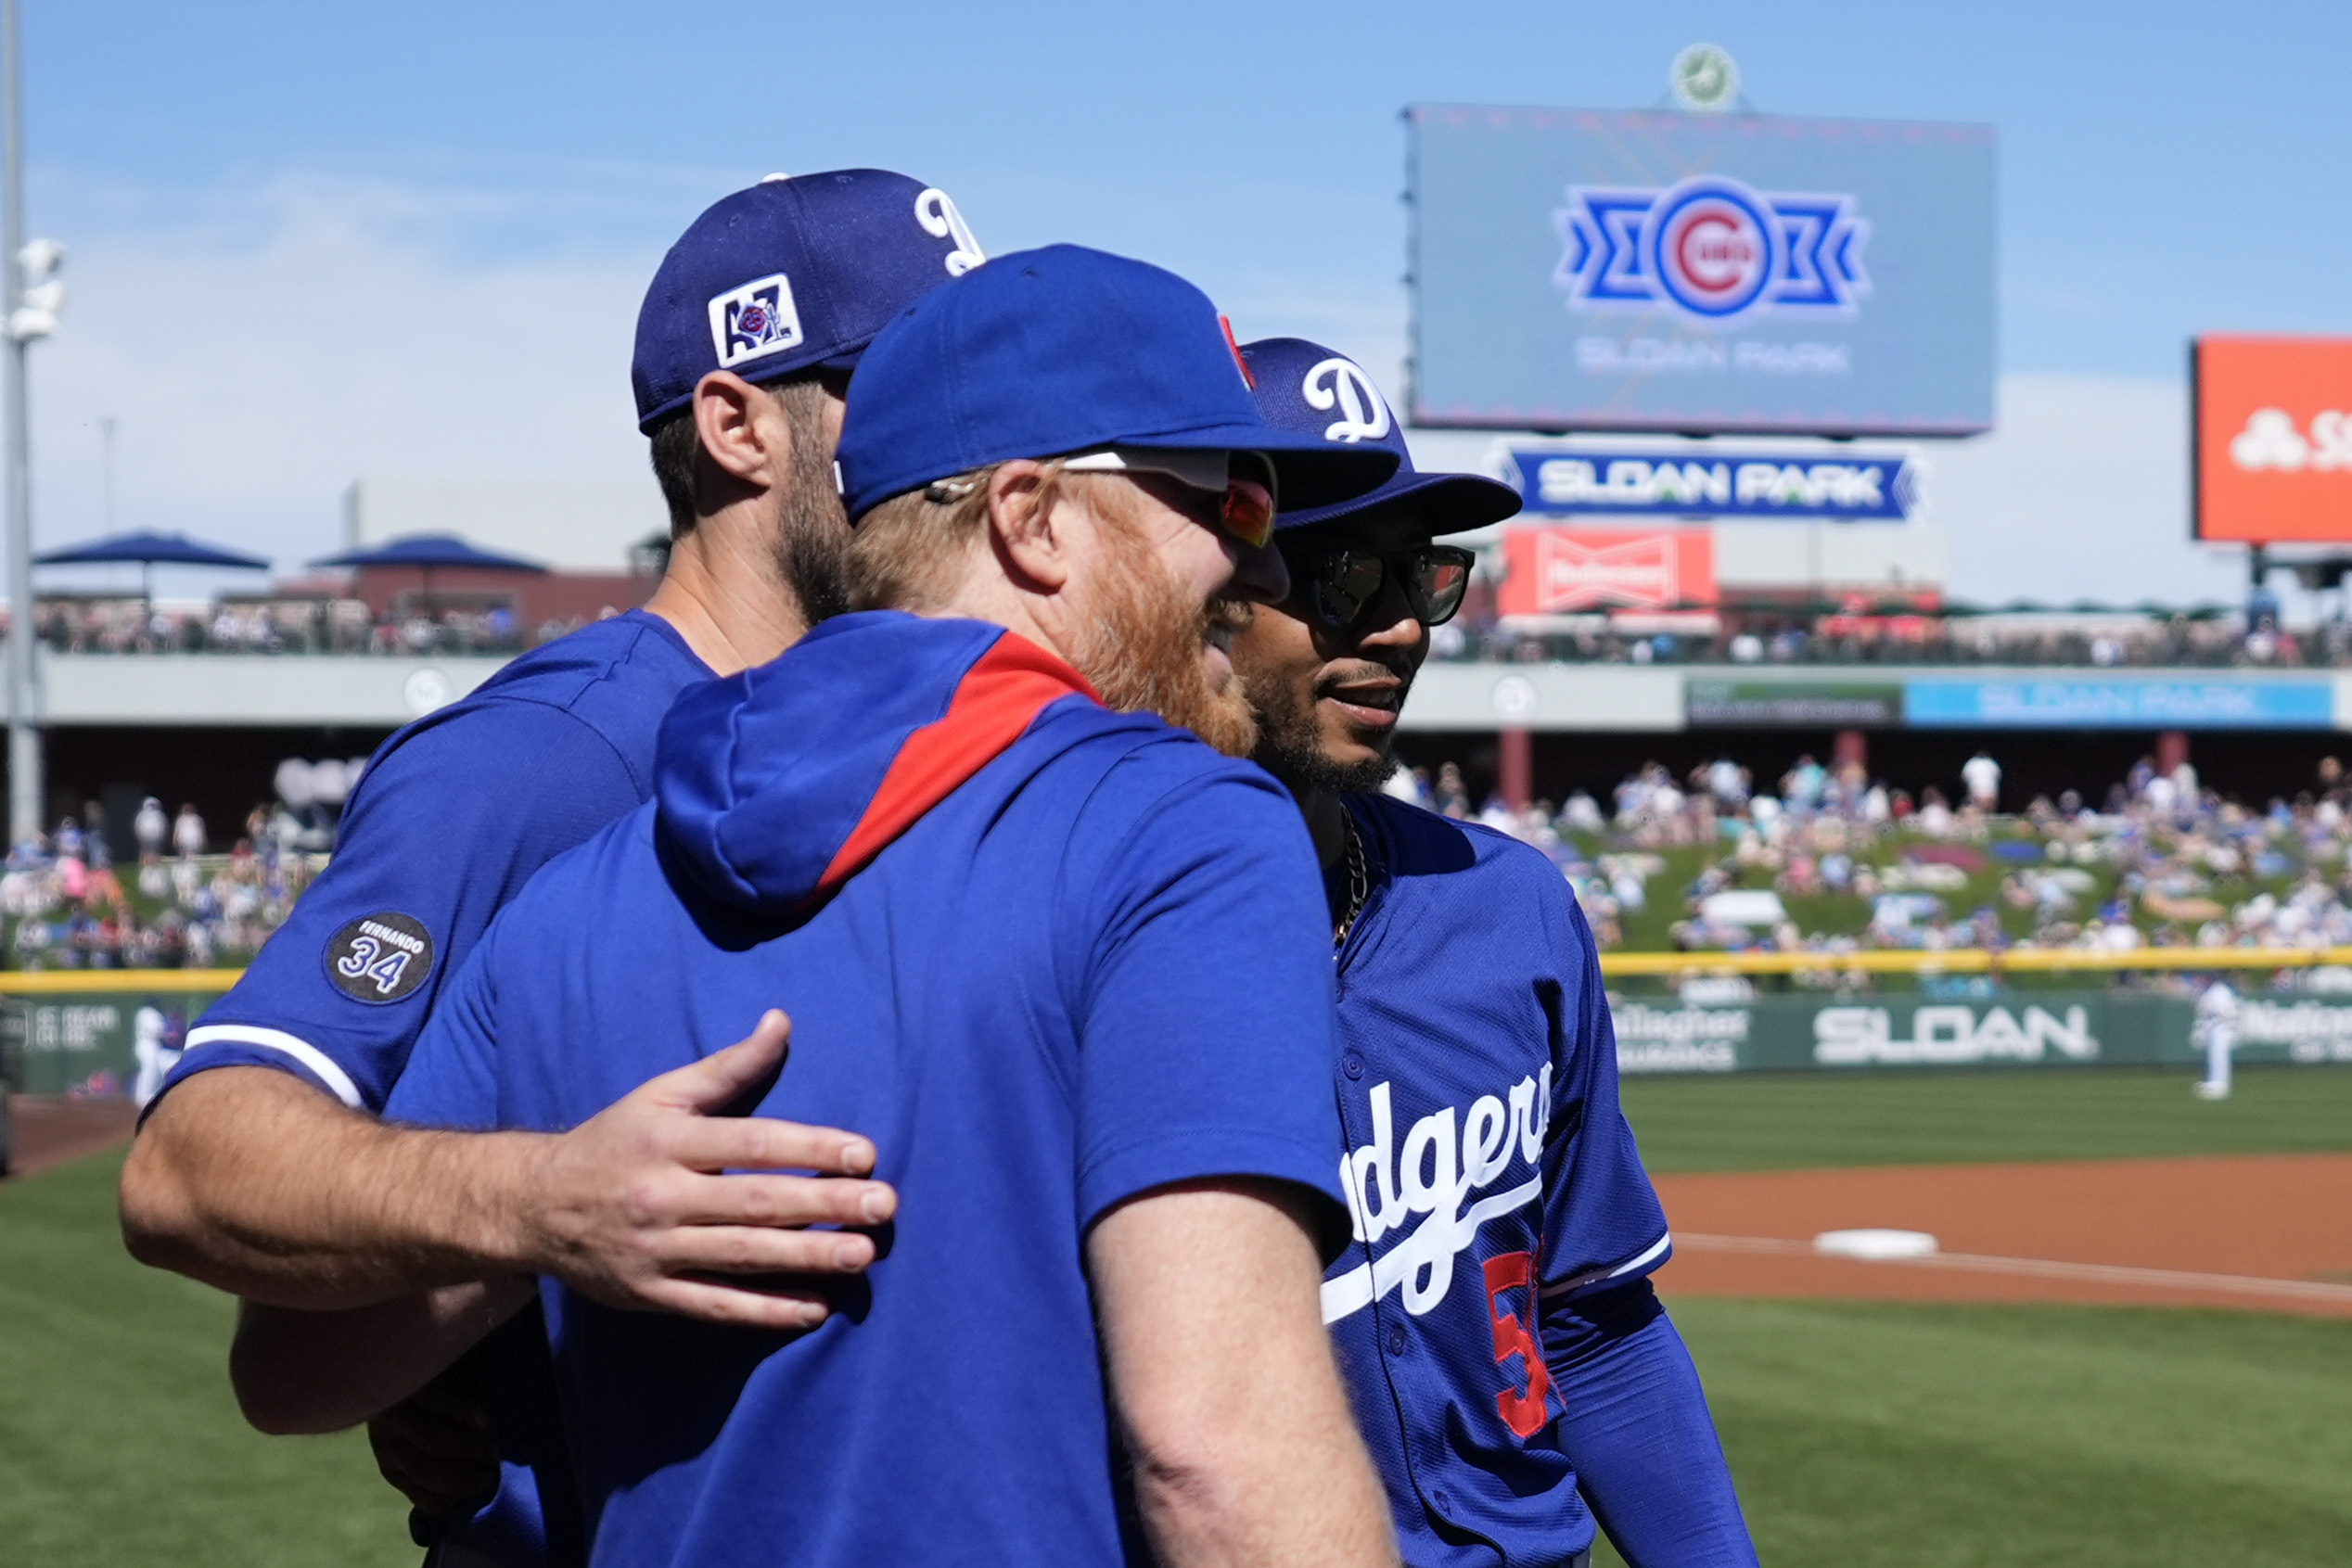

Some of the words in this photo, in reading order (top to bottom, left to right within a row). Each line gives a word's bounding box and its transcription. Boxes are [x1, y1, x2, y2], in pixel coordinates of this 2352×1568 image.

[1577, 335, 1726, 368] SLOAN
[1731, 339, 1851, 371] PARK
[1302, 358, 1390, 443] D
[2310, 410, 2352, 471] S
[1537, 459, 1729, 503] SLOAN
[1735, 461, 1885, 505] PARK
[1978, 683, 2131, 717] SLOAN
[2135, 683, 2259, 716] PARK
[337, 935, 412, 994] 34
[358, 920, 425, 954] FERNANDO
[1812, 1005, 2090, 1064] SLOAN
[1482, 1235, 1567, 1438] 5
